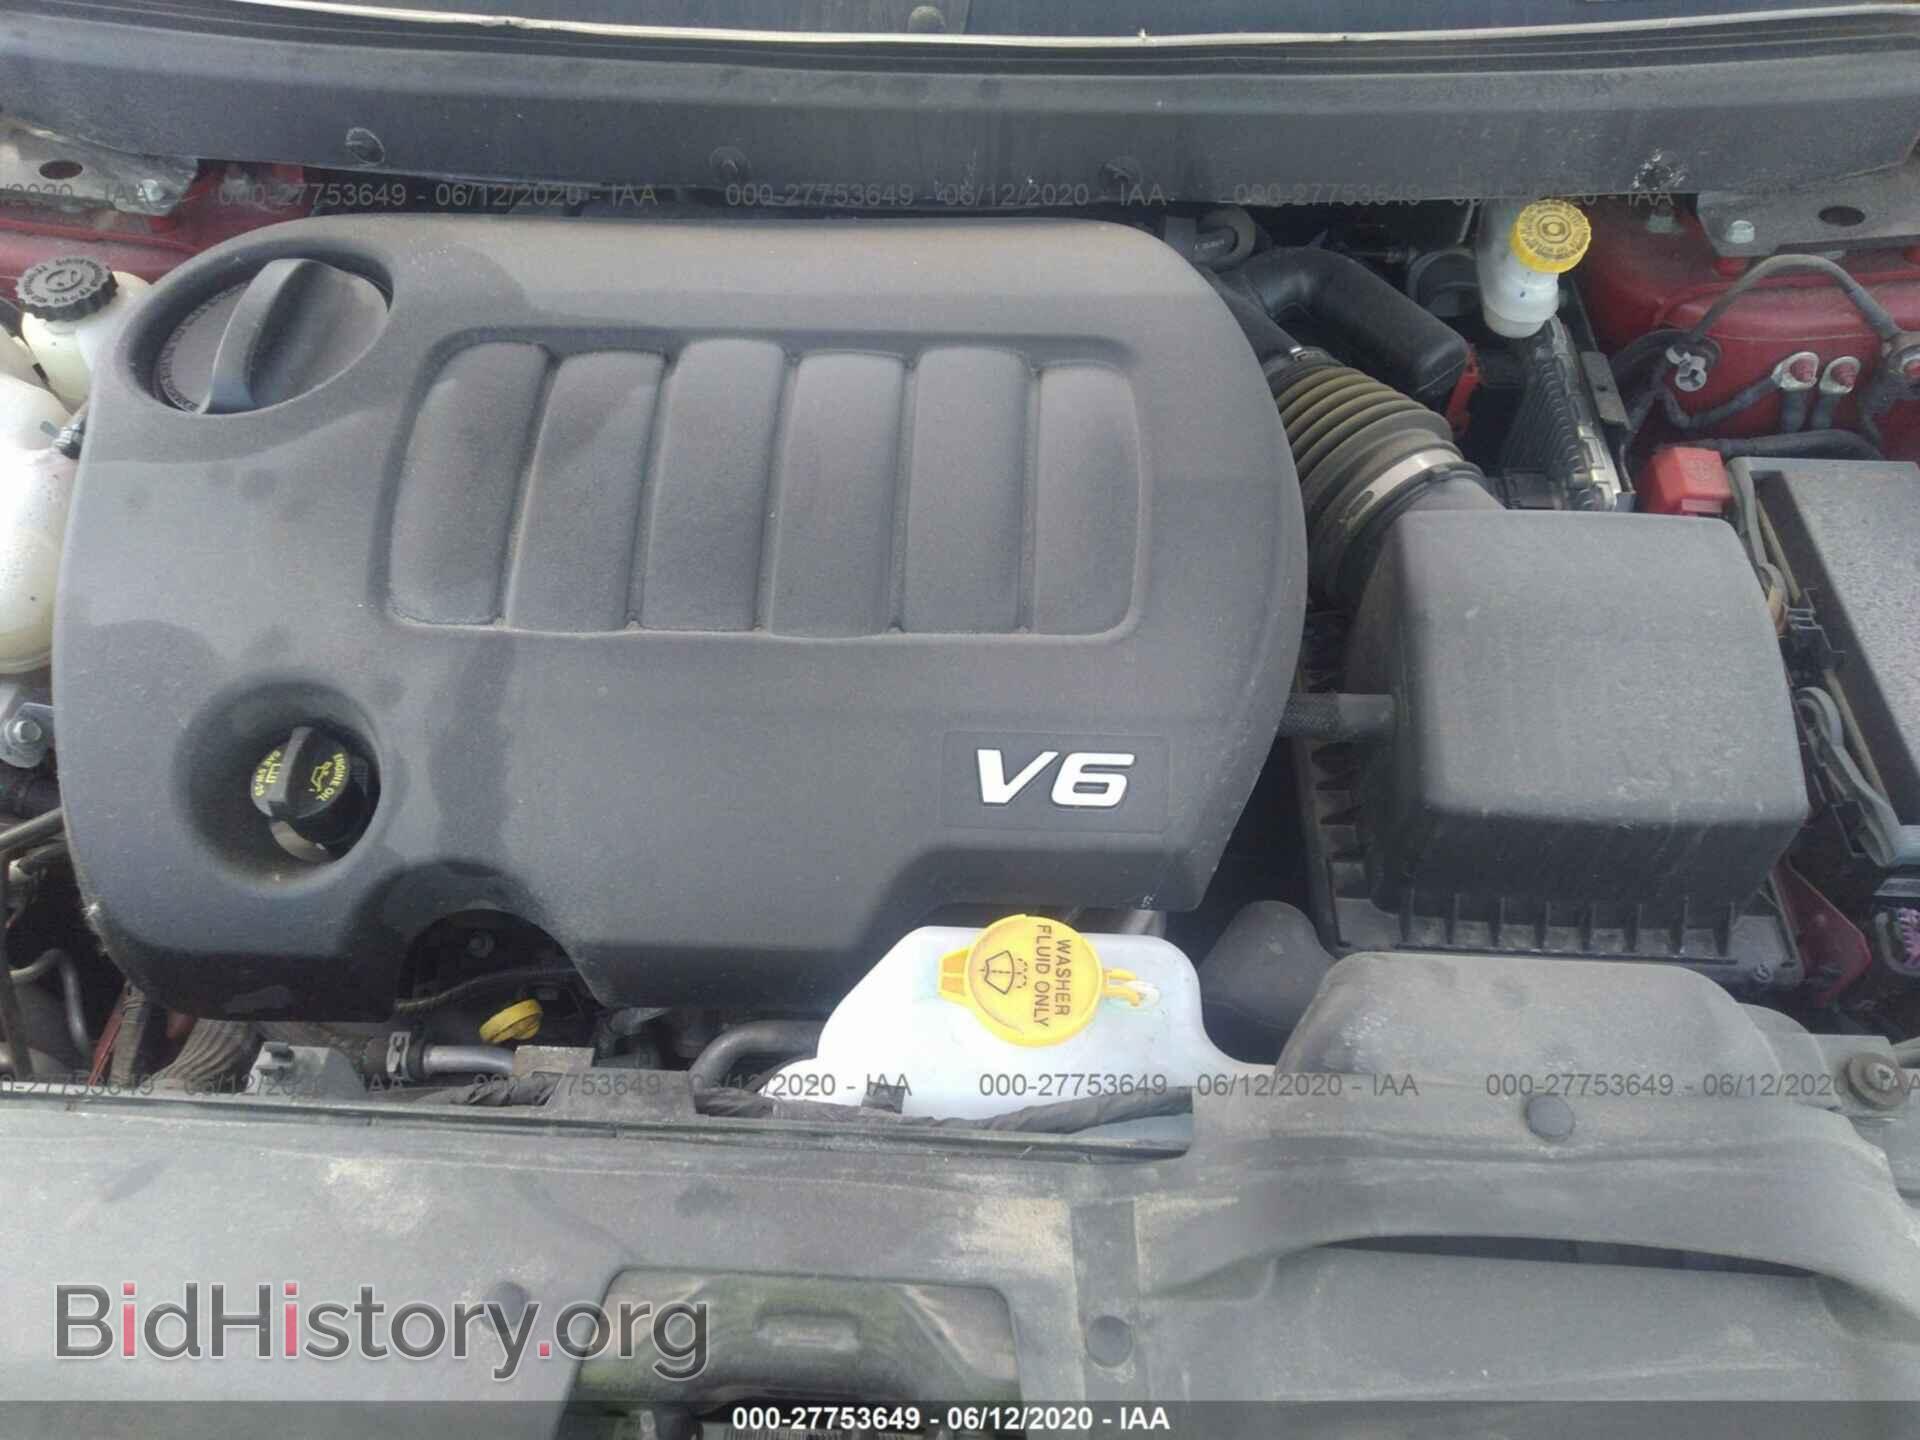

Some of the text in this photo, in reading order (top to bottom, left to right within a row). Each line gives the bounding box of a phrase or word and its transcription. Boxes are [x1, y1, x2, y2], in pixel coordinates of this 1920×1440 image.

[315, 787, 335, 801] OIL
[977, 748, 1136, 807] V6
[1034, 924, 1052, 1028] FLUID ONLY
[1055, 939, 1071, 1016] WASHER
